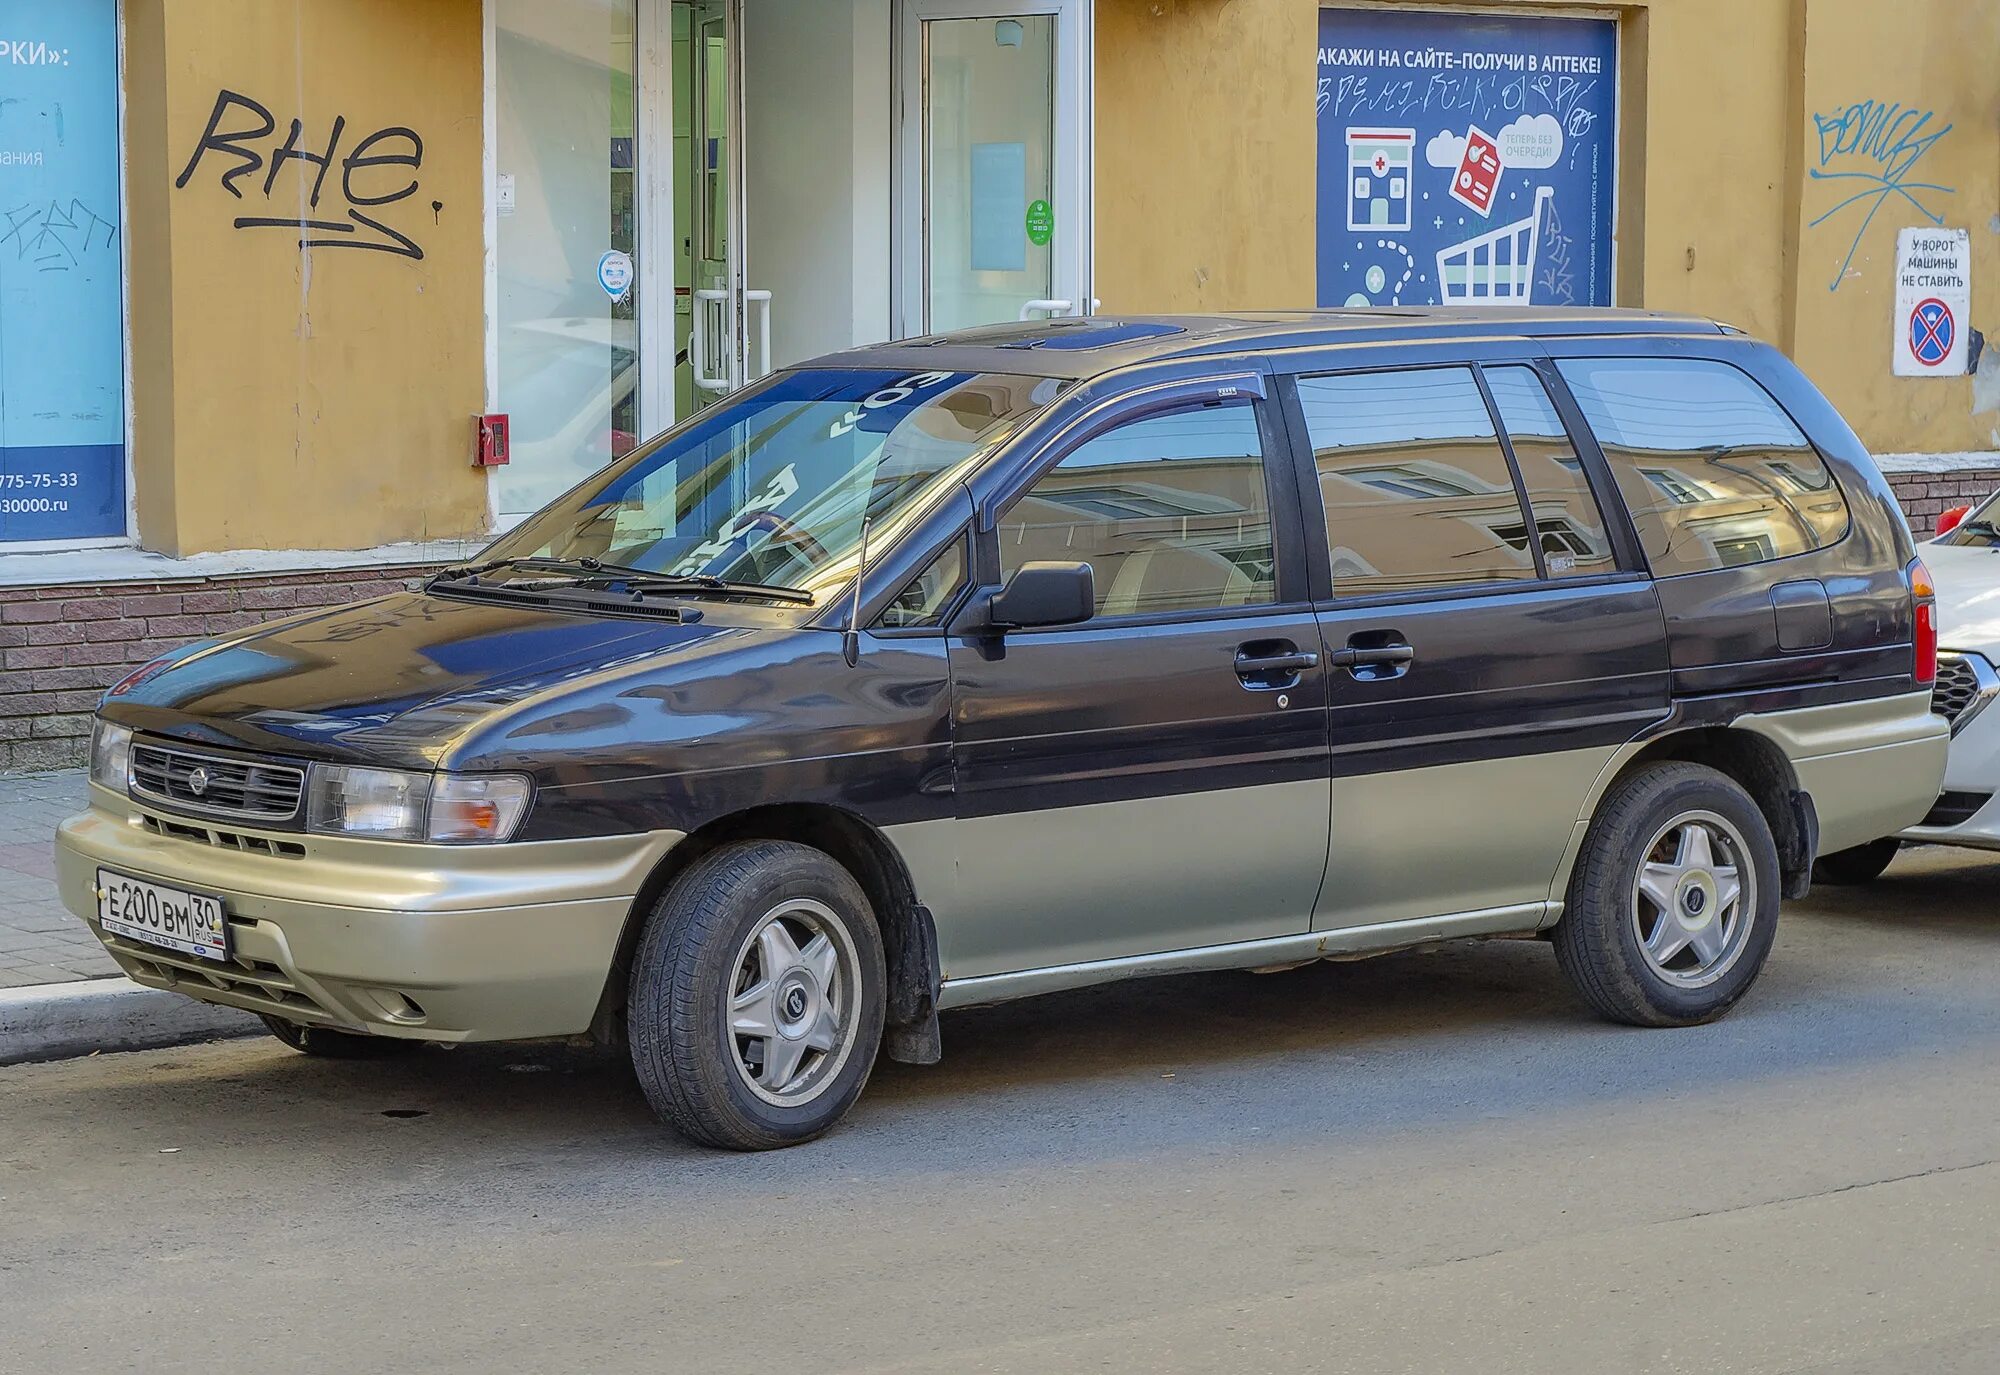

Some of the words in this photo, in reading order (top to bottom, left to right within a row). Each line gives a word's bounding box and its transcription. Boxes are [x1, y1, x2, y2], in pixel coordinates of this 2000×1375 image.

[1317, 47, 1374, 66] АКАЖИ
[1378, 49, 1400, 67] НА
[1528, 54, 1538, 71] В
[1541, 55, 1601, 74] АПТЕКЕ!
[1505, 134, 1536, 144] ТЕПЕРЬ
[1538, 134, 1553, 145] БЕЗ
[0, 151, 44, 165] ания
[1505, 146, 1552, 158] ОЧЕРЕДИ!
[1912, 239, 1920, 251] У
[1922, 239, 1955, 251] ВОРОТ
[1908, 257, 1958, 270] МАШИНЫ
[1901, 275, 1915, 287] НЕ
[1917, 275, 1964, 288] СТАВИТЬ
[0, 498, 68, 513] 30000.ru
[192, 897, 215, 931] 30
[195, 928, 212, 943] RUS
